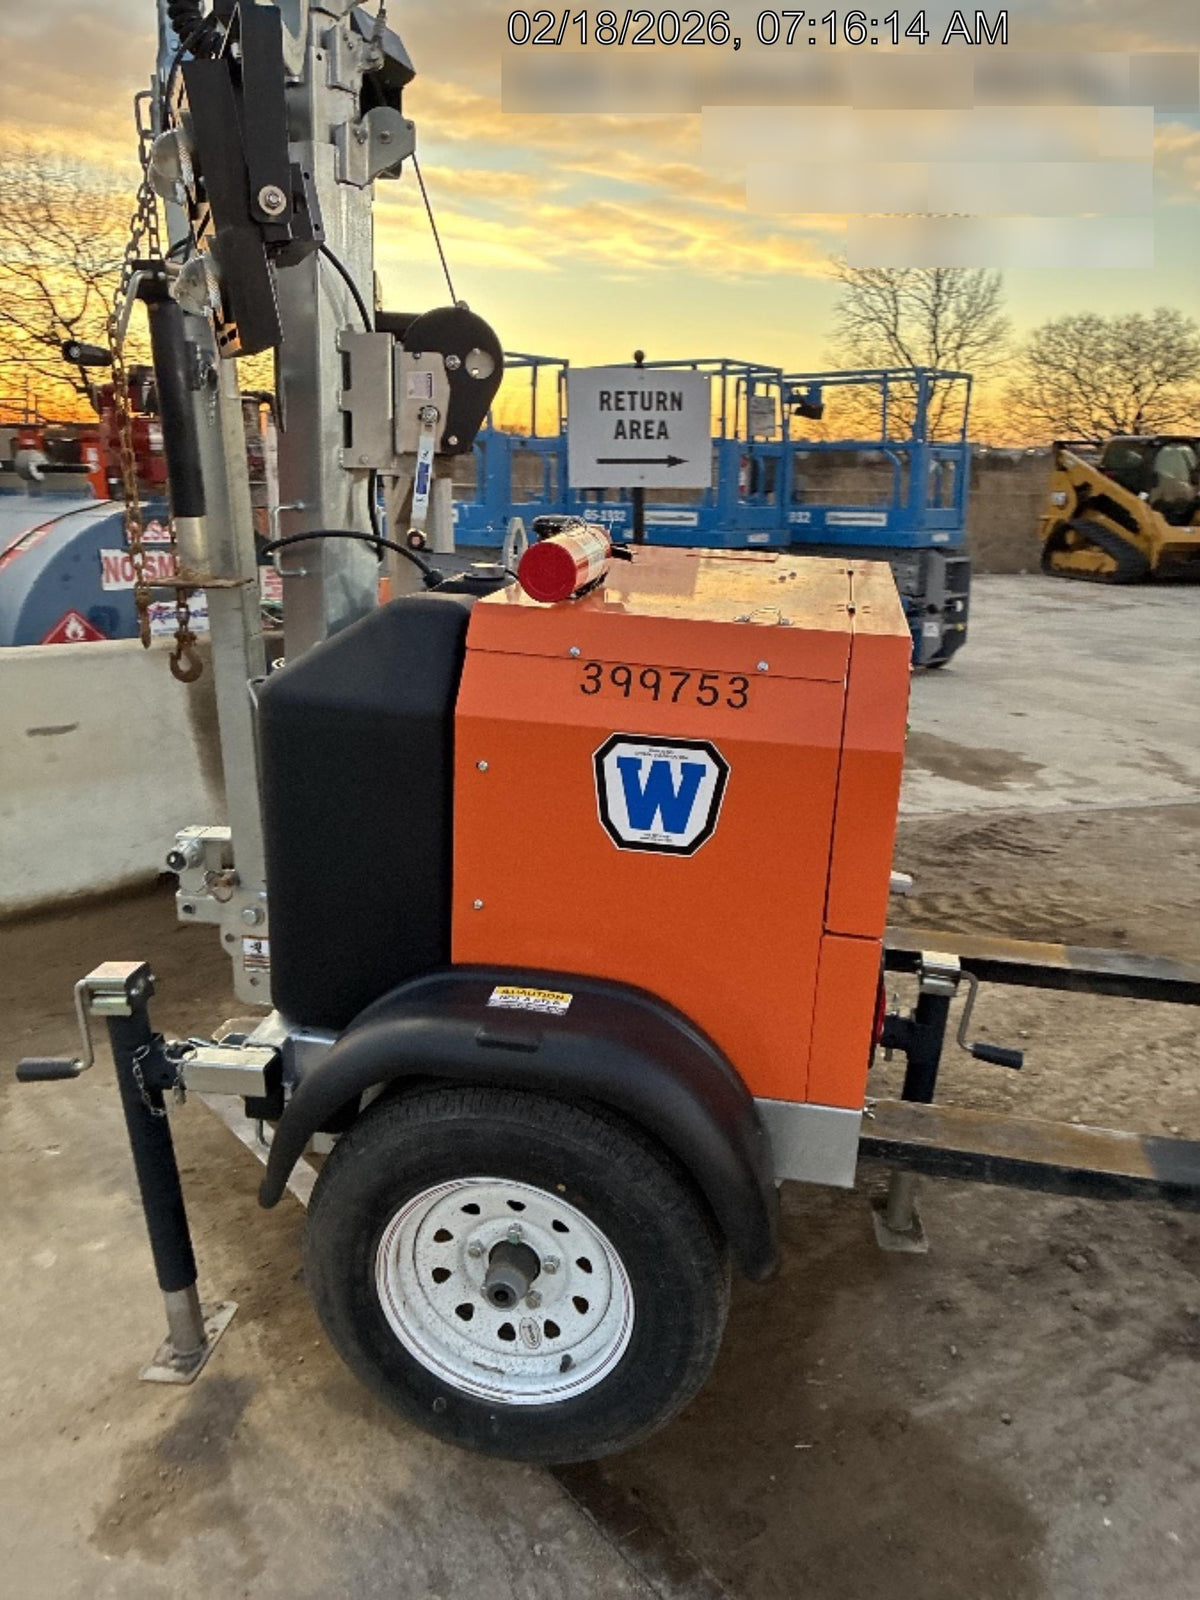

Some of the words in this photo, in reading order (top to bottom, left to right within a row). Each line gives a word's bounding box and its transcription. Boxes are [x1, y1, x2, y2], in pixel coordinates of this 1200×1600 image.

[599, 390, 683, 411] RETURN
[613, 419, 669, 440] AREA
[103, 555, 136, 583] NO
[580, 662, 749, 709] 399753
[616, 756, 706, 834] W
